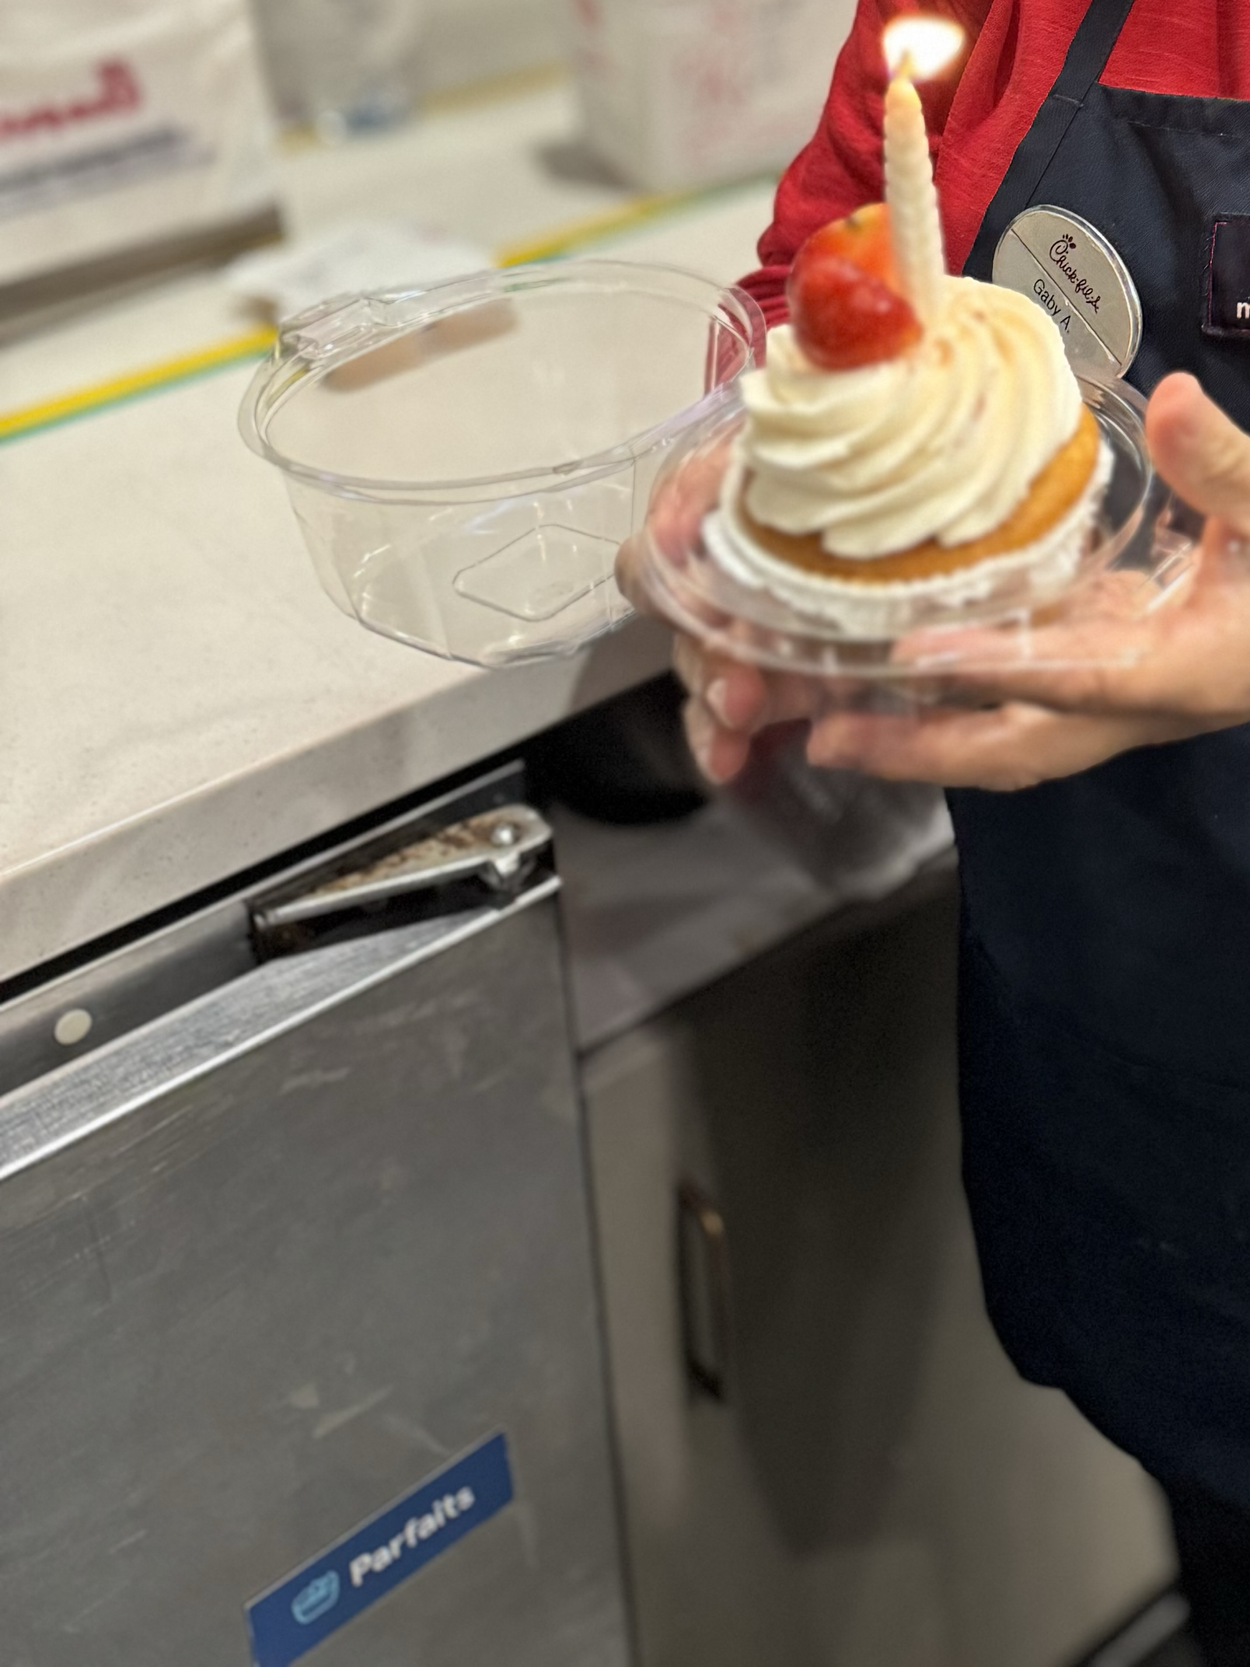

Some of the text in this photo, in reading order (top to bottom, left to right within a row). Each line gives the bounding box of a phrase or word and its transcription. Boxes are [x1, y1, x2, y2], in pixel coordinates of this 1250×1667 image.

[1033, 278, 1072, 334] Gaby A.
[1049, 237, 1101, 314] Chick-fil-A
[349, 1485, 476, 1588] Parfaits
